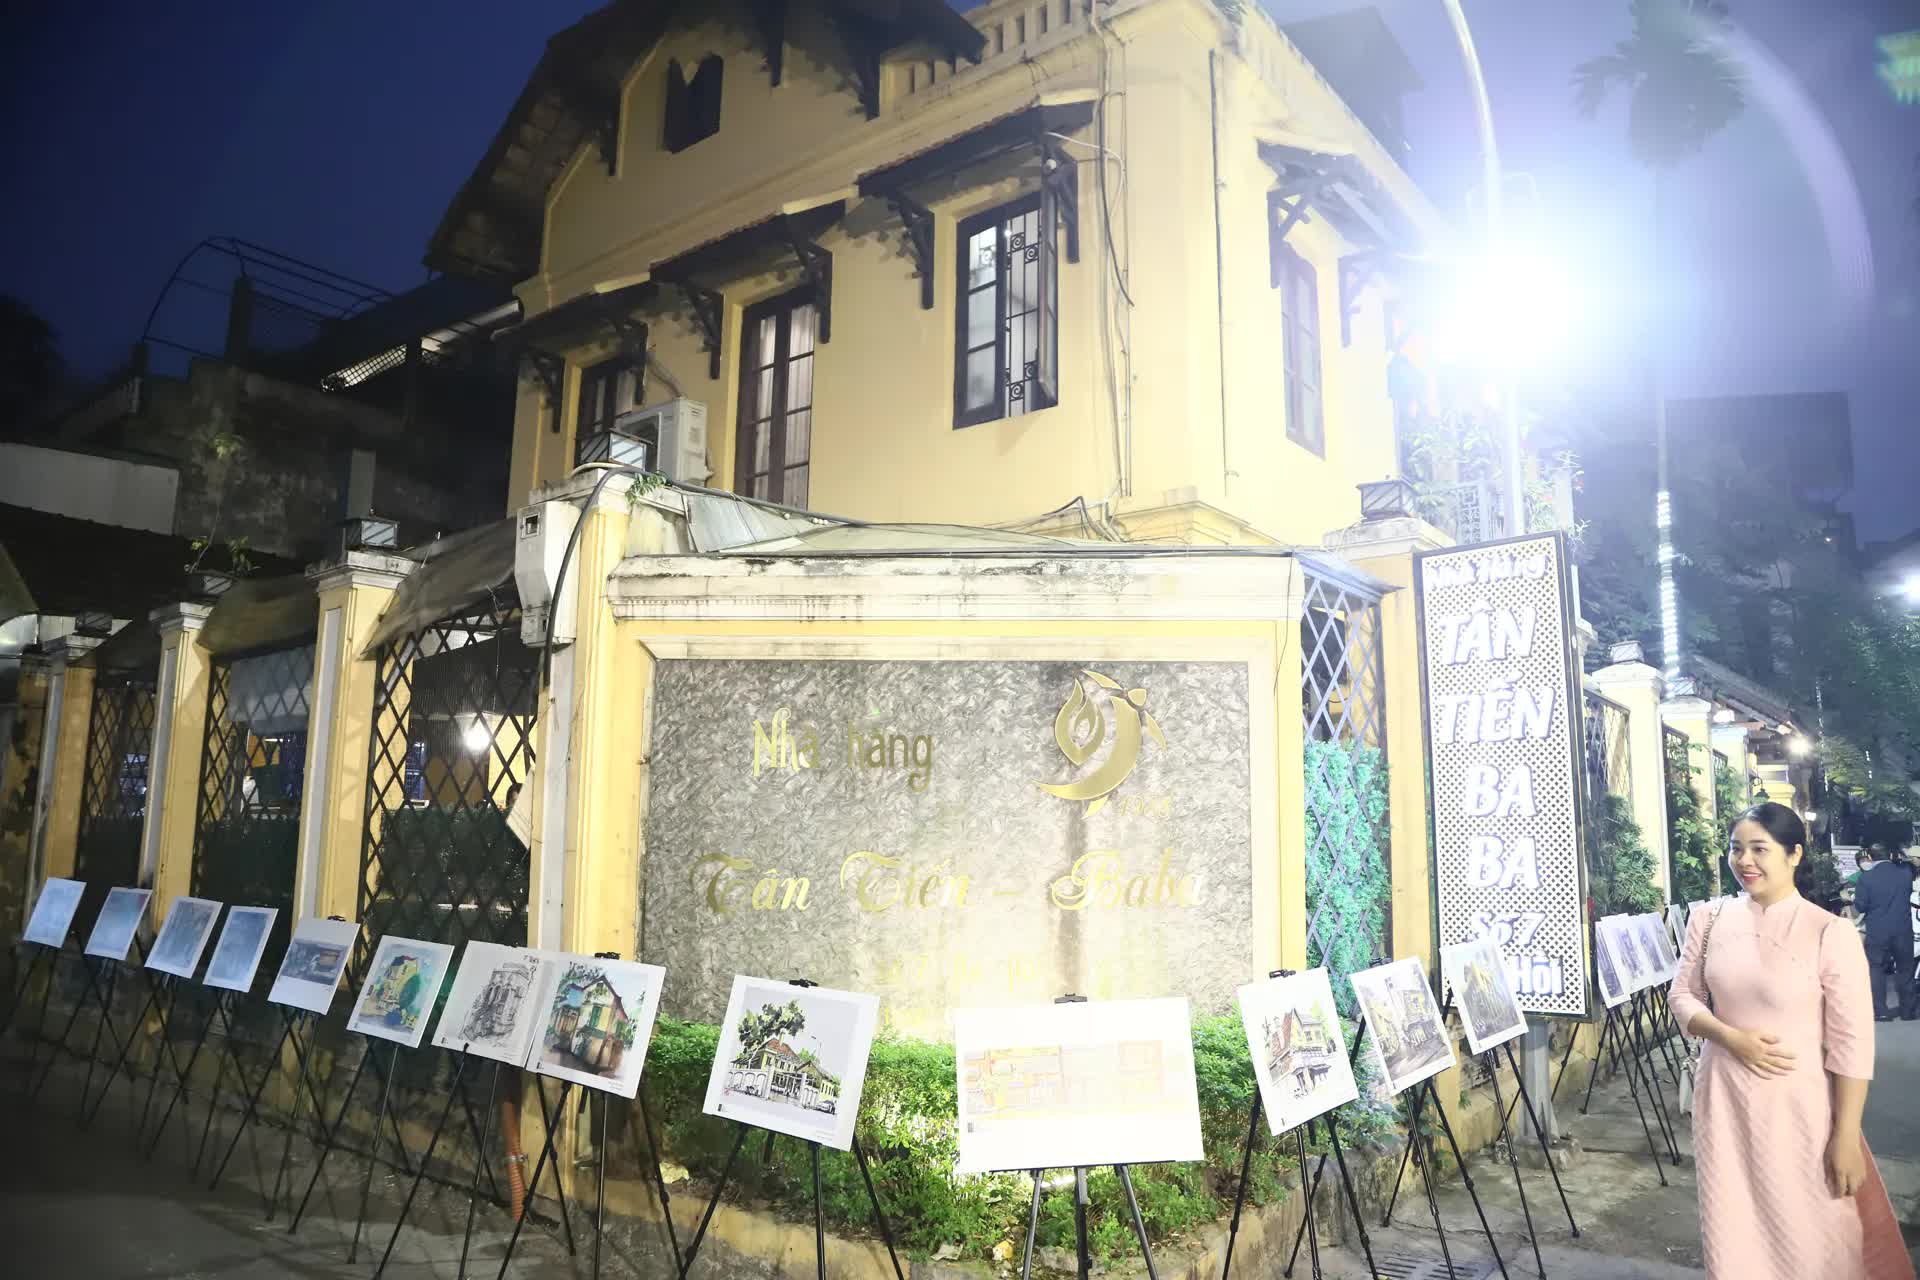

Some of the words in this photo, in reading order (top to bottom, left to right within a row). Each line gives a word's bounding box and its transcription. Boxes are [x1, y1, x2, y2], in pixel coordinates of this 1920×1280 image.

[1440, 598, 1538, 666] TÂN
[1437, 669, 1556, 745] TIẾN
[1465, 762, 1541, 818] BA
[688, 852, 812, 911] Tân
[1468, 833, 1543, 890] BA
